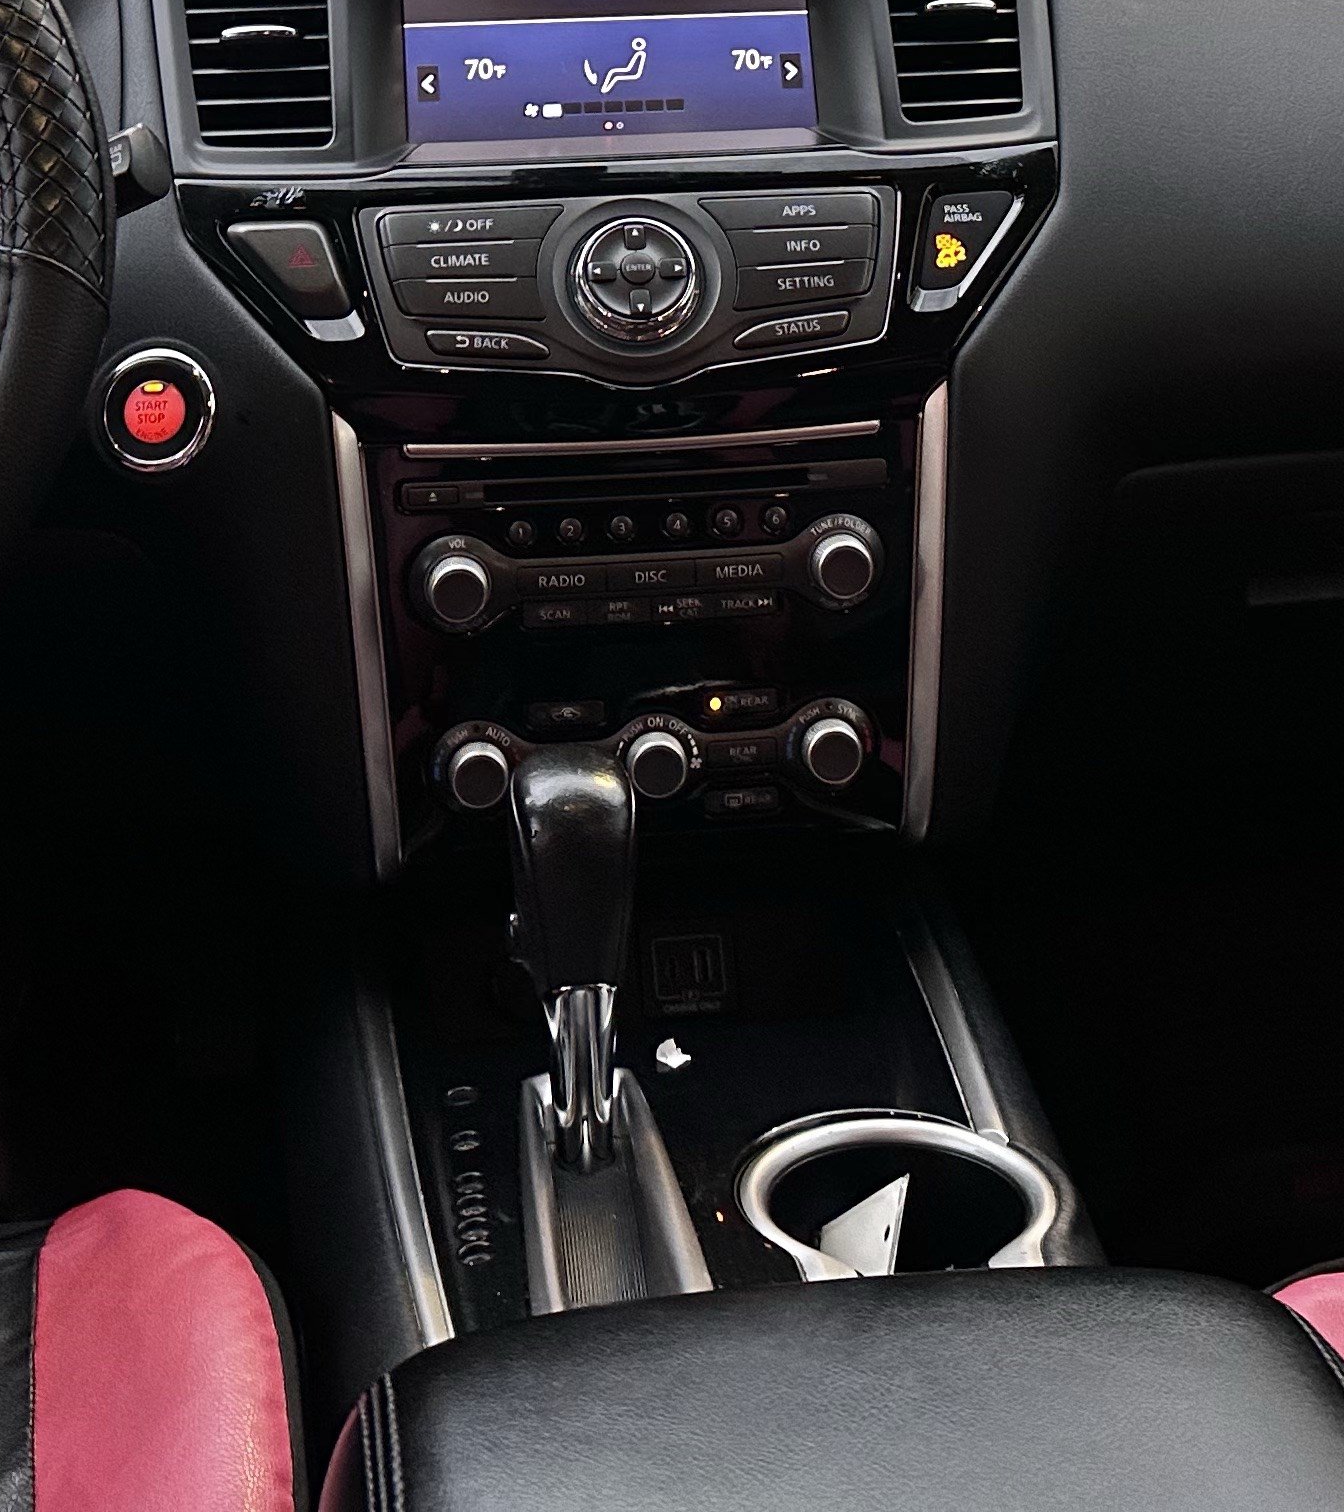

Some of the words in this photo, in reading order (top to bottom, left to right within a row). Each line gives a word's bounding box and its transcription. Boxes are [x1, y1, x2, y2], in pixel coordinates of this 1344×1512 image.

[782, 203, 816, 219] APPS
[943, 204, 970, 216] PASS
[464, 218, 493, 231] OFF
[942, 212, 982, 224] AIRBAG
[786, 238, 821, 253] INFO
[430, 252, 490, 268] CLIMATE
[625, 262, 653, 273] ENTER
[776, 272, 835, 291] SETTING
[443, 289, 490, 305] AUDIO
[774, 318, 822, 336] STATUS
[472, 334, 509, 351] BACK
[135, 400, 169, 412] START
[137, 413, 166, 425] STOP
[672, 518, 682, 532] 4
[722, 514, 733, 528] 5
[771, 512, 781, 526] 6
[516, 526, 525, 539] 1
[565, 524, 576, 538] 2
[617, 521, 627, 535] 3
[447, 538, 468, 551] VOL
[634, 568, 668, 585] DISC
[715, 562, 764, 580] MEDIA
[537, 572, 586, 589] RADIO
[675, 597, 703, 609] SEEK
[720, 598, 754, 610] TRACK
[539, 610, 571, 622] SCAN
[740, 694, 770, 707] REAR
[798, 705, 821, 725] PUSH
[646, 715, 664, 729] ON
[667, 718, 688, 735] OFF
[484, 725, 512, 748] AUTO
